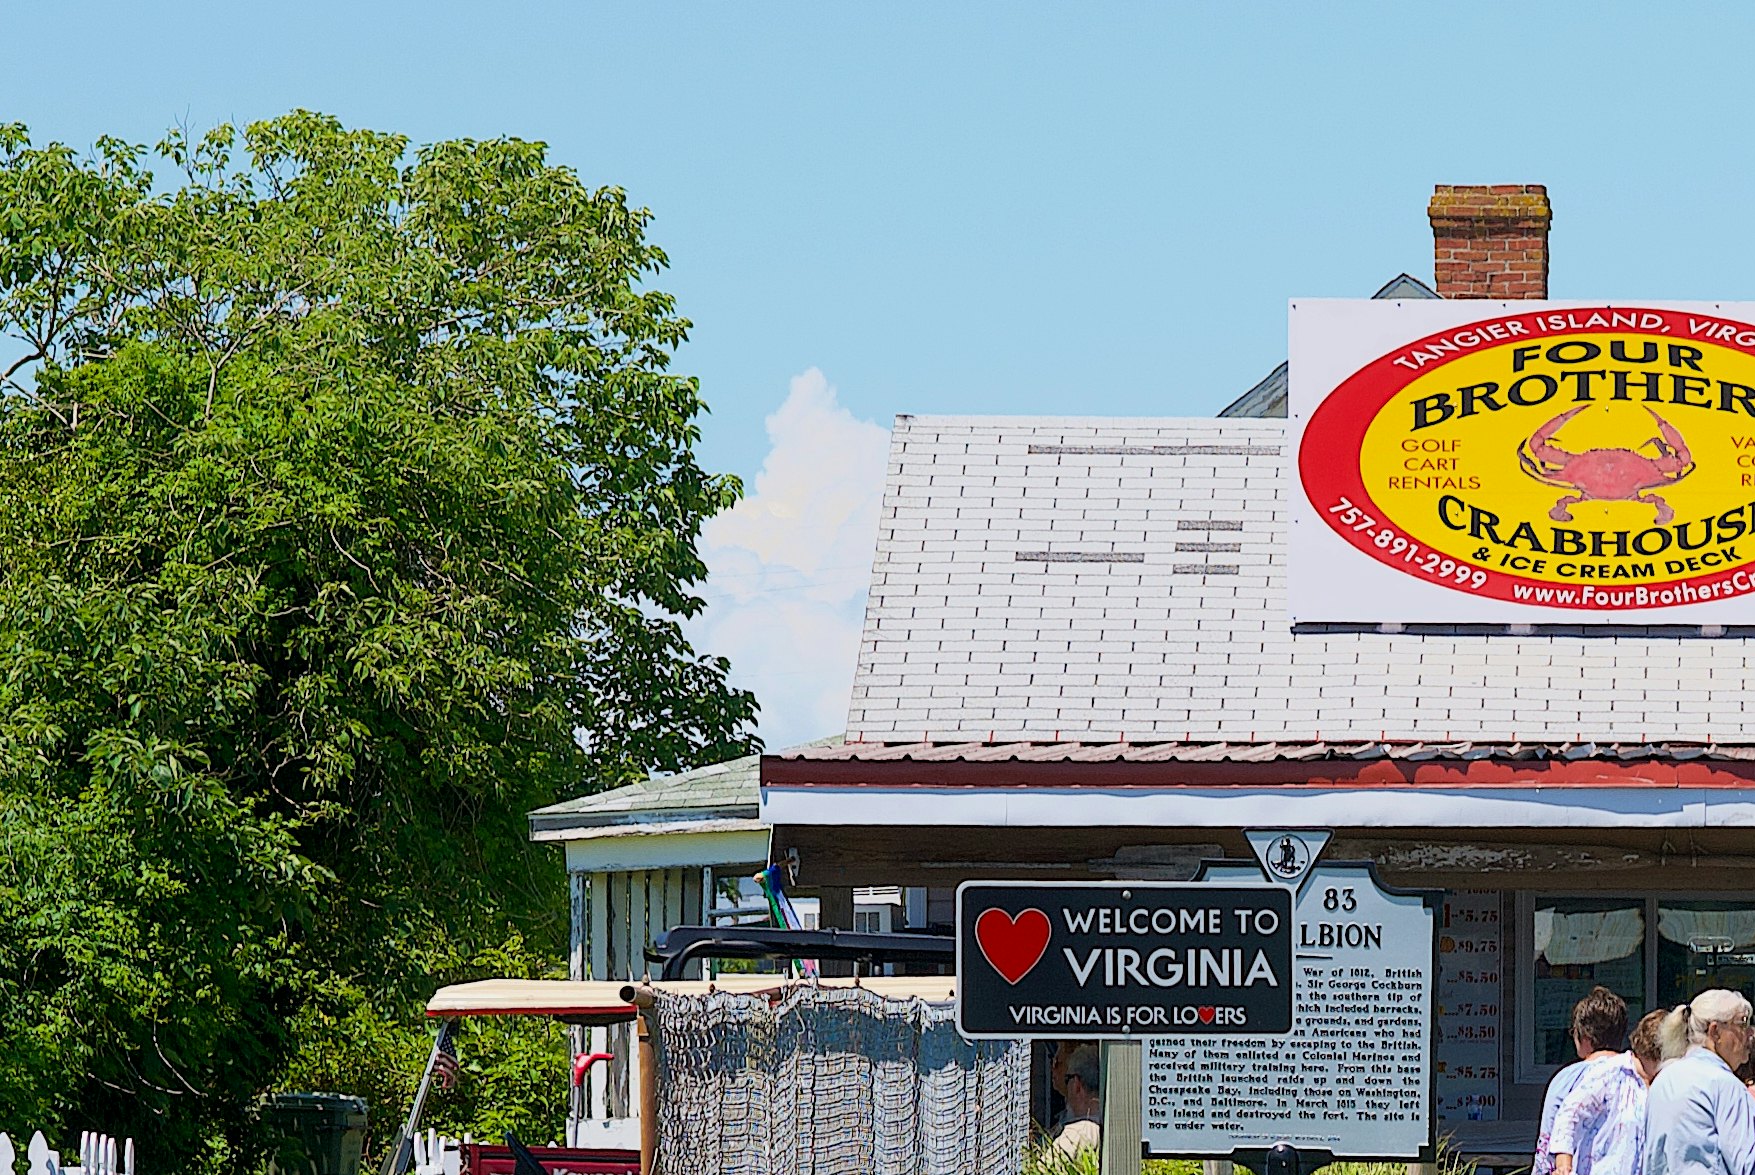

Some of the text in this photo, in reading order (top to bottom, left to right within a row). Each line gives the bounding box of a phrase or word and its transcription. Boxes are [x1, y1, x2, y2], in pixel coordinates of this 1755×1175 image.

[1394, 320, 1529, 370] TANGIER
[1536, 312, 1670, 333] ISLAND,
[1513, 340, 1703, 372] FOUR
[1401, 439, 1461, 452] GOLF
[1404, 458, 1460, 471] CART
[1388, 476, 1481, 490] RENTALS
[1328, 496, 1488, 590] 757-891-2999
[1472, 546, 1742, 579] & ICE CREAM DECK
[1323, 887, 1357, 911] 83
[1062, 908, 1279, 935] WELCOME TO
[1297, 922, 1382, 949] LBION
[1062, 947, 1279, 987] VIRGINIA
[1302, 967, 1323, 977] War
[1330, 968, 1344, 977] of
[1385, 968, 1422, 979] British
[1307, 979, 1324, 989] Sir
[1328, 979, 1366, 991] George
[1371, 980, 1422, 990] Cockburn
[1308, 990, 1326, 1001] the
[1332, 991, 1380, 1002] southern
[1386, 992, 1403, 1003] tip
[1409, 992, 1422, 1002] of
[1009, 1005, 1102, 1025] VIRGINIA
[1106, 1006, 1122, 1025] IS
[1127, 1006, 1170, 1025] FOR
[1296, 1003, 1320, 1013] hich
[1325, 1003, 1369, 1014] included
[1354, 1016, 1374, 1026] and
[1311, 1026, 1366, 1038] Americans
[1373, 1027, 1394, 1038] who
[1402, 1028, 1421, 1038] had
[1149, 1038, 1185, 1049] gained
[1190, 1038, 1217, 1047] their
[1221, 1037, 1266, 1048] freedom
[1271, 1038, 1286, 1049] by
[1289, 1039, 1336, 1051] escaping
[1340, 1040, 1352, 1049] to
[1357, 1040, 1375, 1050] the
[1149, 1048, 1420, 1062] Many of them enlisted as Colonial Marines and
[1148, 1060, 1195, 1071] received
[1200, 1061, 1246, 1073] military
[1251, 1062, 1296, 1074] training
[1337, 1063, 1365, 1073] From
[1370, 1063, 1392, 1074] this
[1396, 1064, 1420, 1074] base
[1149, 1072, 1420, 1086] the British launched raids up and down the
[1148, 1084, 1210, 1097] Chesapeake
[1248, 1085, 1298, 1098] including
[1303, 1087, 1332, 1097] those
[1338, 1089, 1351, 1097] on
[1183, 1096, 1202, 1106] and
[1276, 1098, 1287, 1108] In
[1295, 1098, 1328, 1109] March
[1365, 1099, 1390, 1111] they
[1398, 1098, 1420, 1110] left
[1148, 1108, 1166, 1118] the
[1173, 1108, 1204, 1119] island
[1210, 1109, 1230, 1119] and
[1235, 1109, 1291, 1120] destroyed
[1298, 1110, 1316, 1120] the
[1355, 1111, 1377, 1121] The
[1383, 1111, 1404, 1121] site
[1410, 1111, 1420, 1121] is
[1148, 1122, 1168, 1130] now
[1174, 1120, 1205, 1130] under
